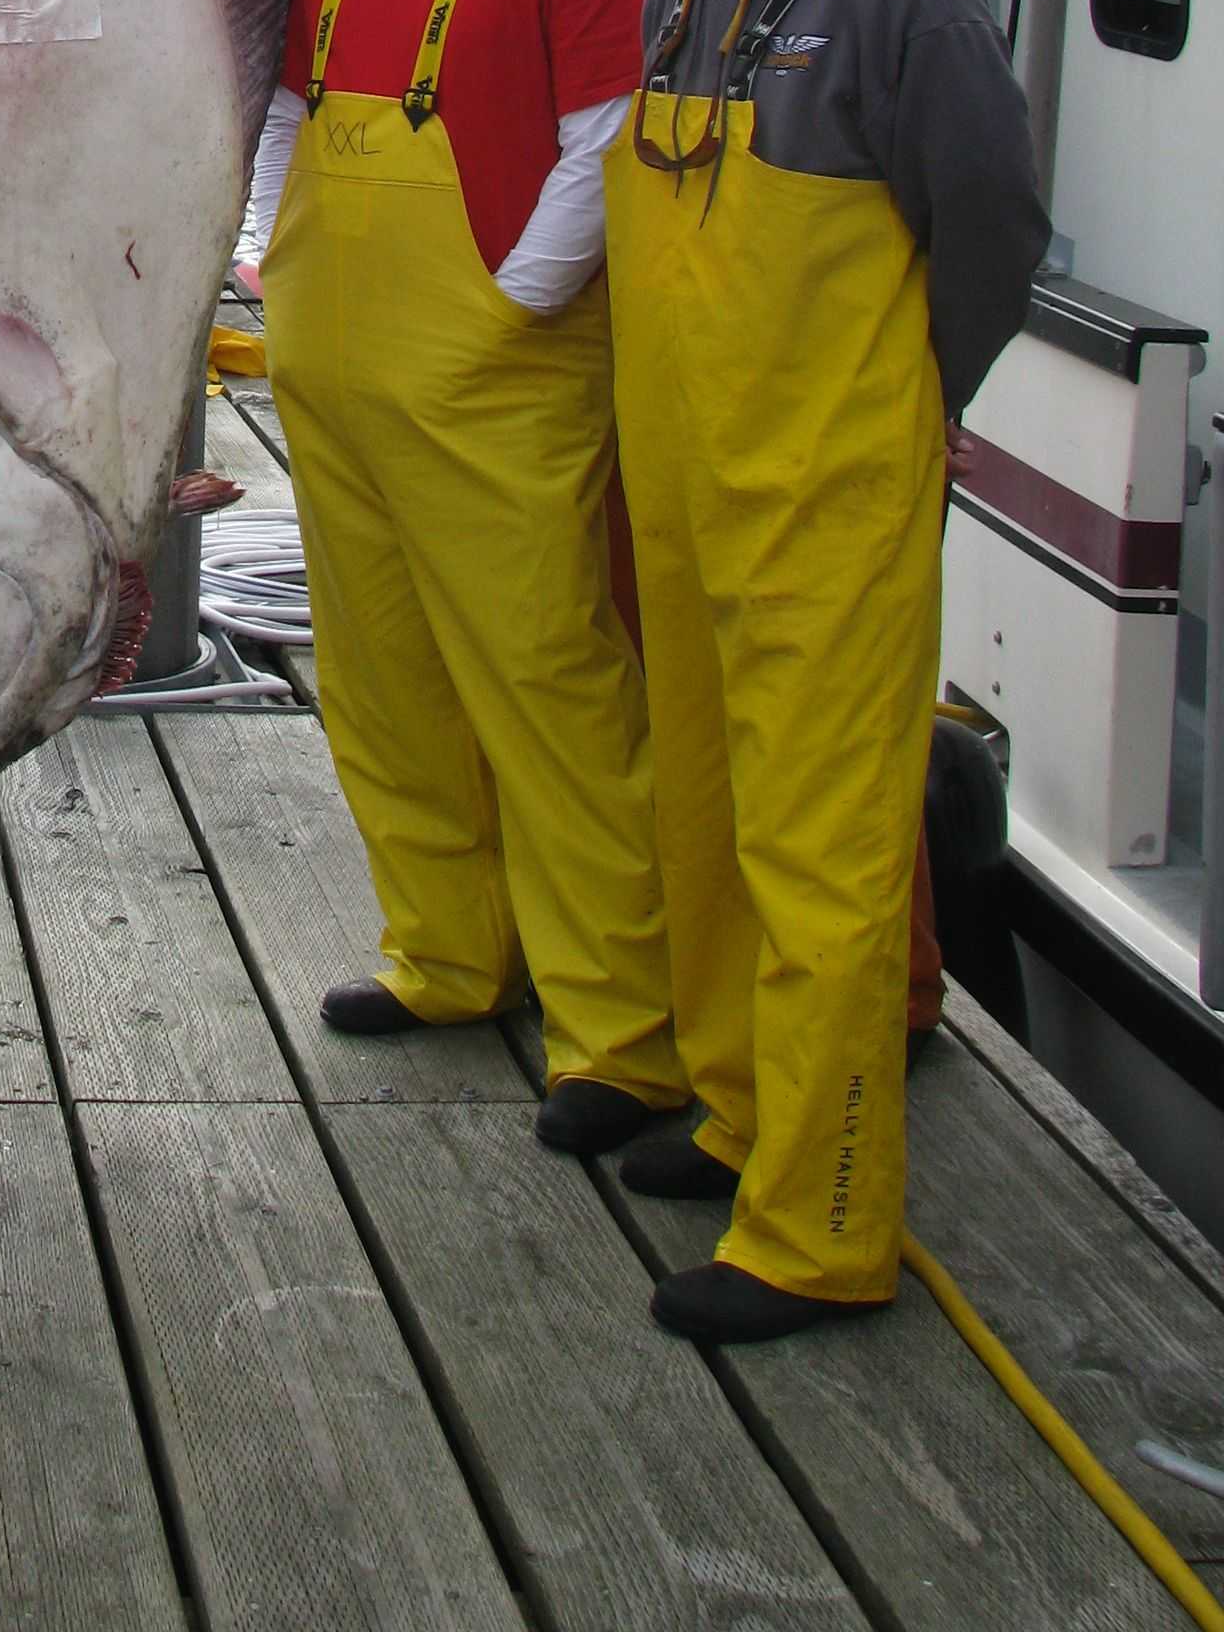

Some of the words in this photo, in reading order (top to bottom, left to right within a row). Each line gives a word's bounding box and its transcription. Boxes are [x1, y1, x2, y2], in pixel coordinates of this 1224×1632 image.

[322, 121, 383, 156] XXL
[844, 1075, 865, 1137] HELLY
[829, 1146, 856, 1233] HANSEN
